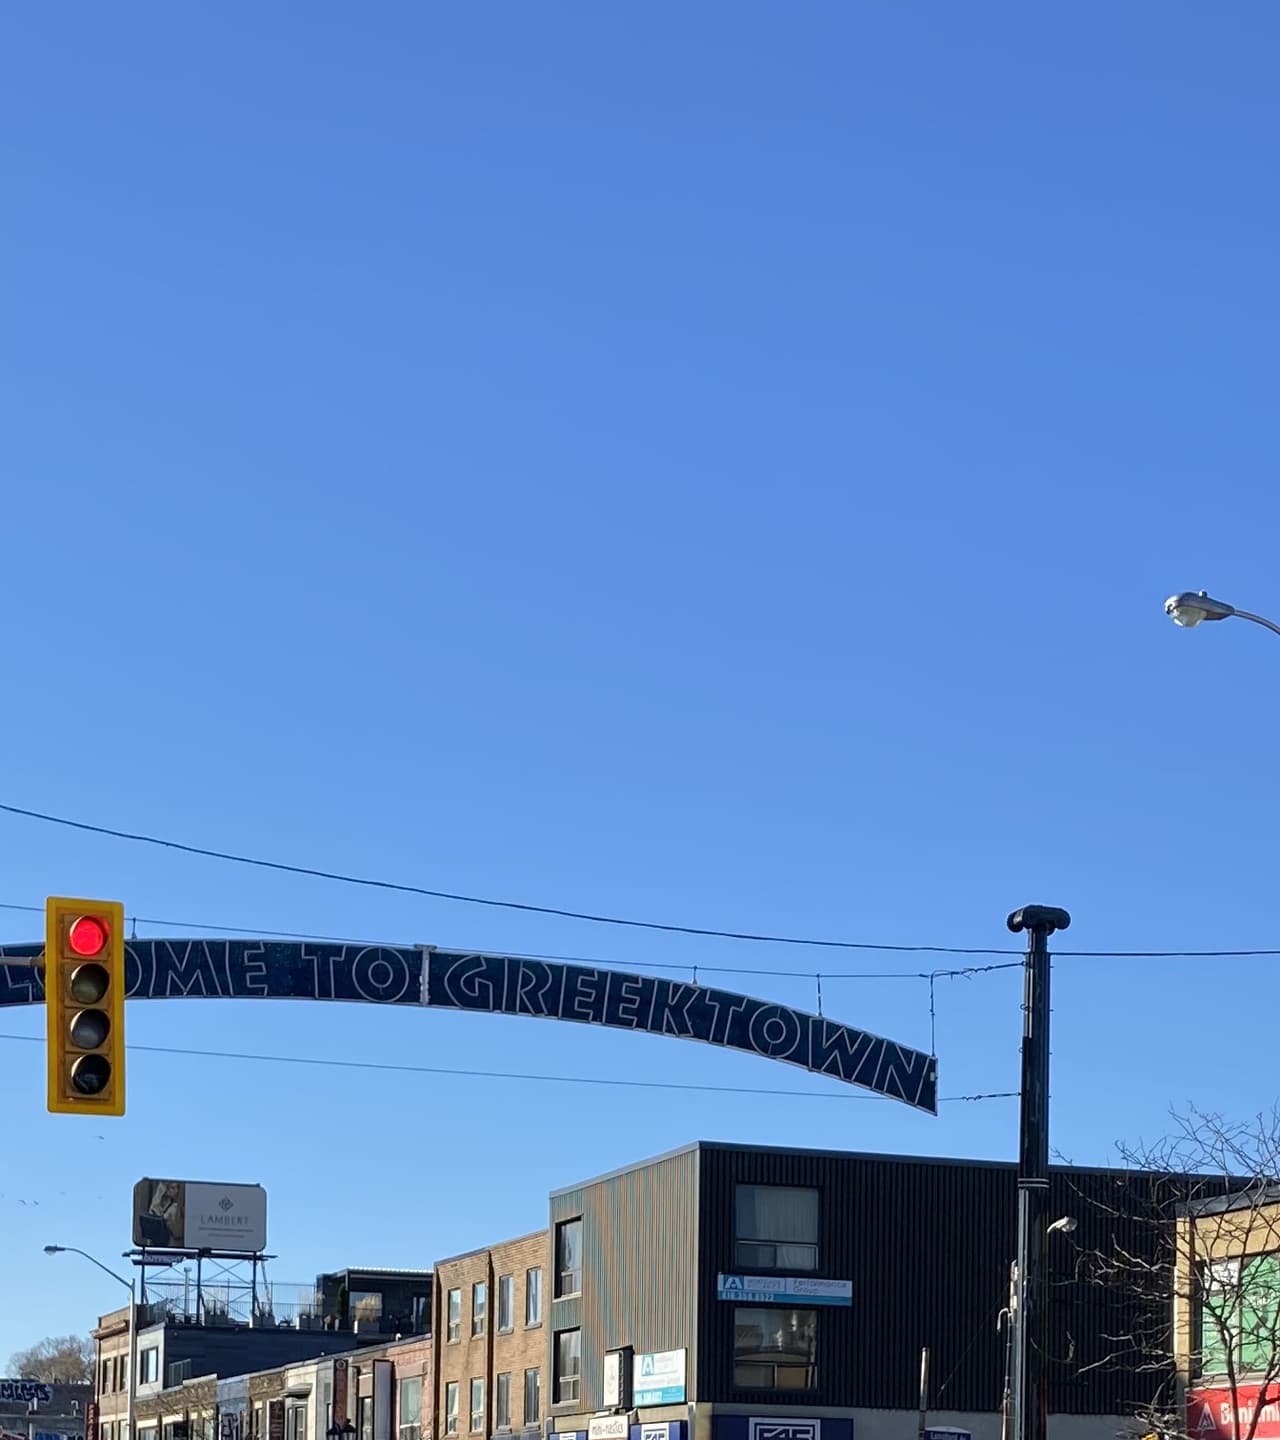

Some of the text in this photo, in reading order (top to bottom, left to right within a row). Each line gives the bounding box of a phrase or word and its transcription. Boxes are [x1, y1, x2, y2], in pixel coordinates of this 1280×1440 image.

[302, 944, 411, 1002] TO
[444, 954, 931, 1105] GREEKTOWN
[200, 1215, 249, 1225] LAMBERT
